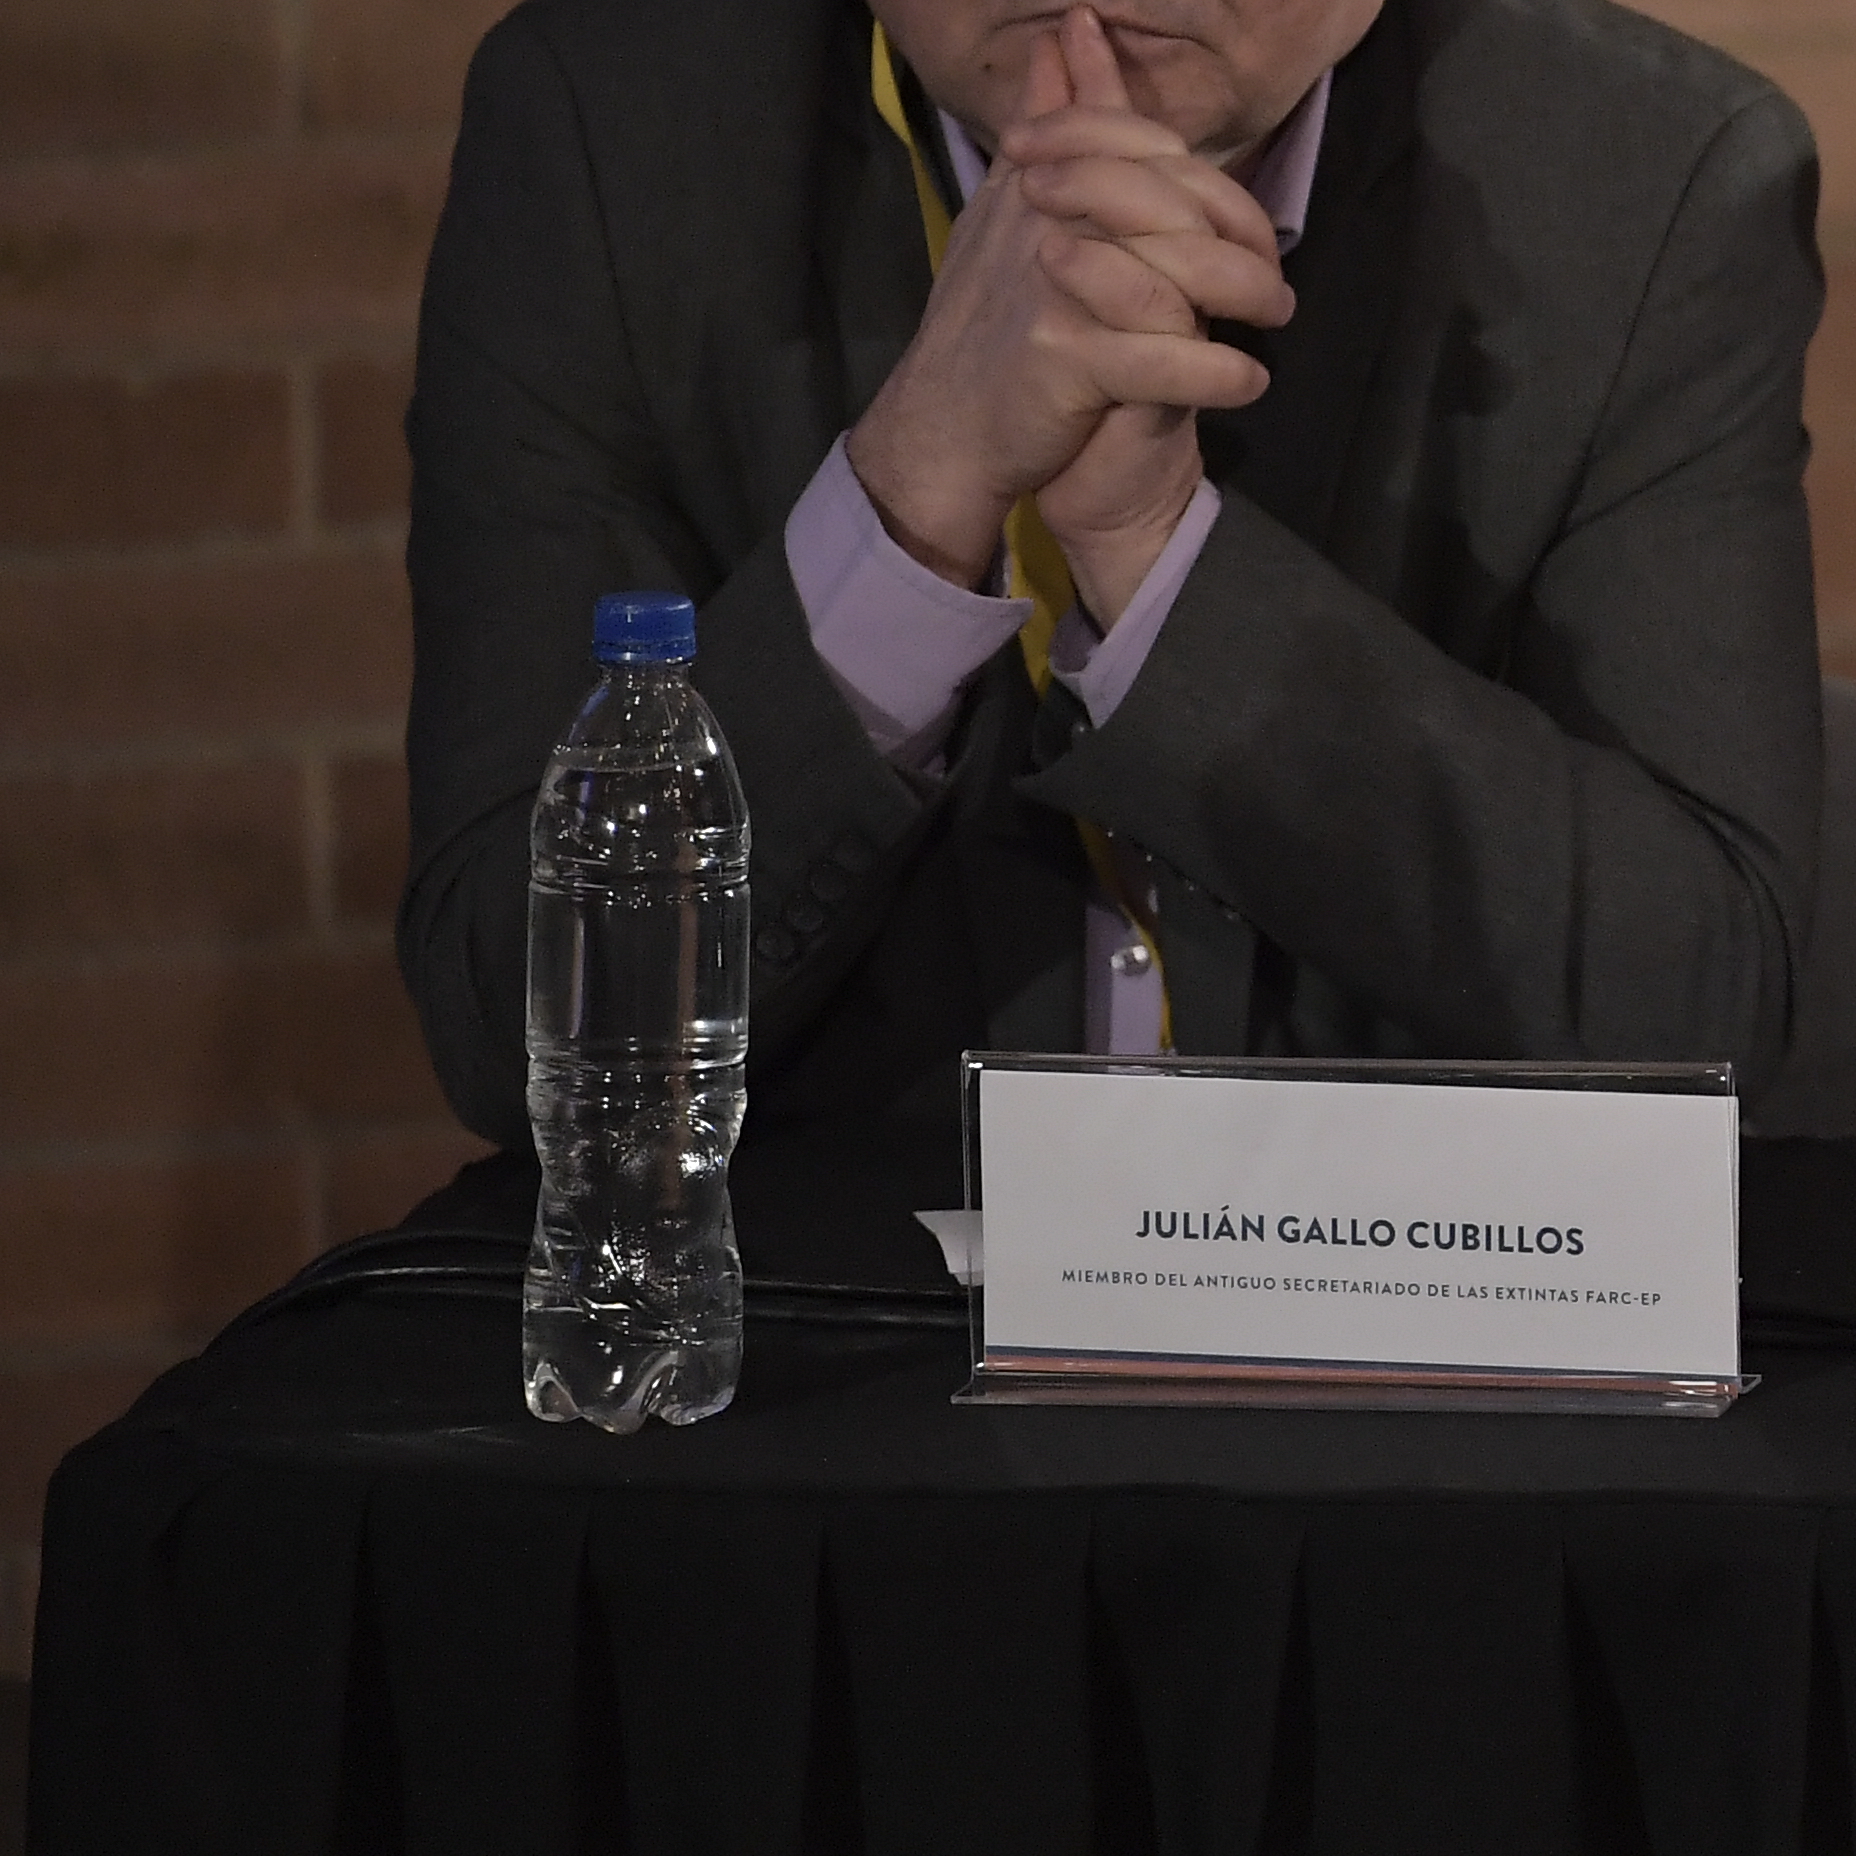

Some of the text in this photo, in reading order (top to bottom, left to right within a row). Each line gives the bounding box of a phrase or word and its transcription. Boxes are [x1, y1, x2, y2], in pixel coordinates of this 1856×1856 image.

[1135, 1204, 1585, 1257] JULIÁN GALLO CUBILLOS
[1061, 1268, 1662, 1307] MIEMBRO DEL ANTIGUO SECRETARIADO DE LAS EXTINTAS FARC-EP
